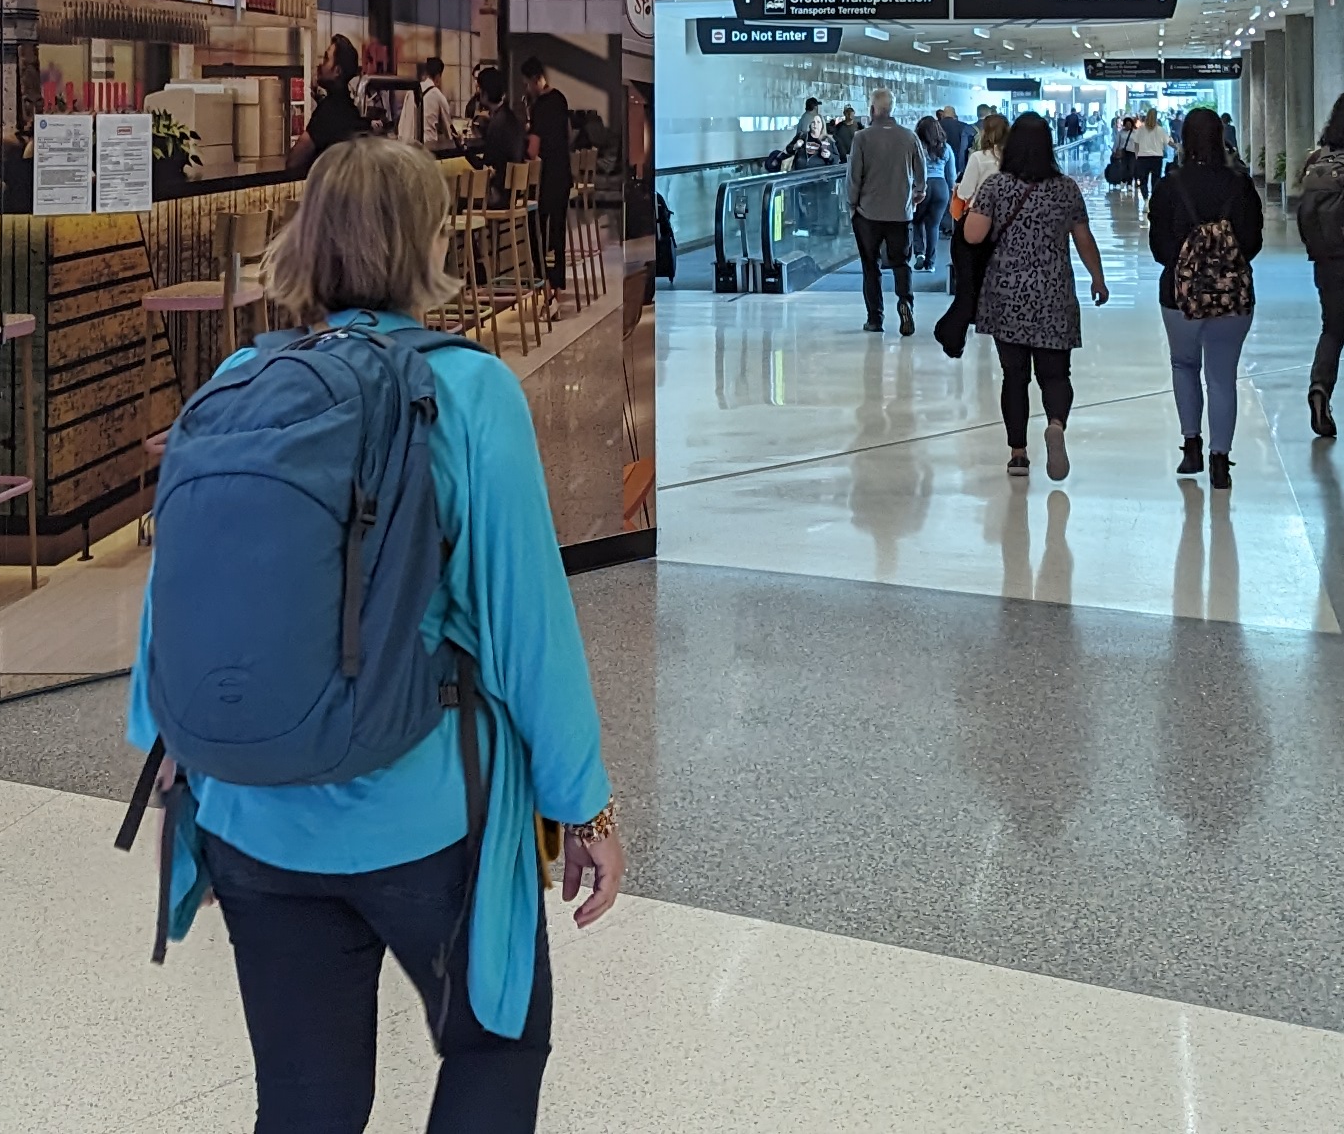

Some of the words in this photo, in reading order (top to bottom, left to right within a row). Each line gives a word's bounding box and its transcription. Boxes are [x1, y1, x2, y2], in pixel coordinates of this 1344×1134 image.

[789, 6, 836, 16] Transporte
[837, 6, 877, 15] Terrestre
[731, 31, 748, 42] Do
[751, 30, 773, 41] Not
[775, 30, 808, 41] Enter
